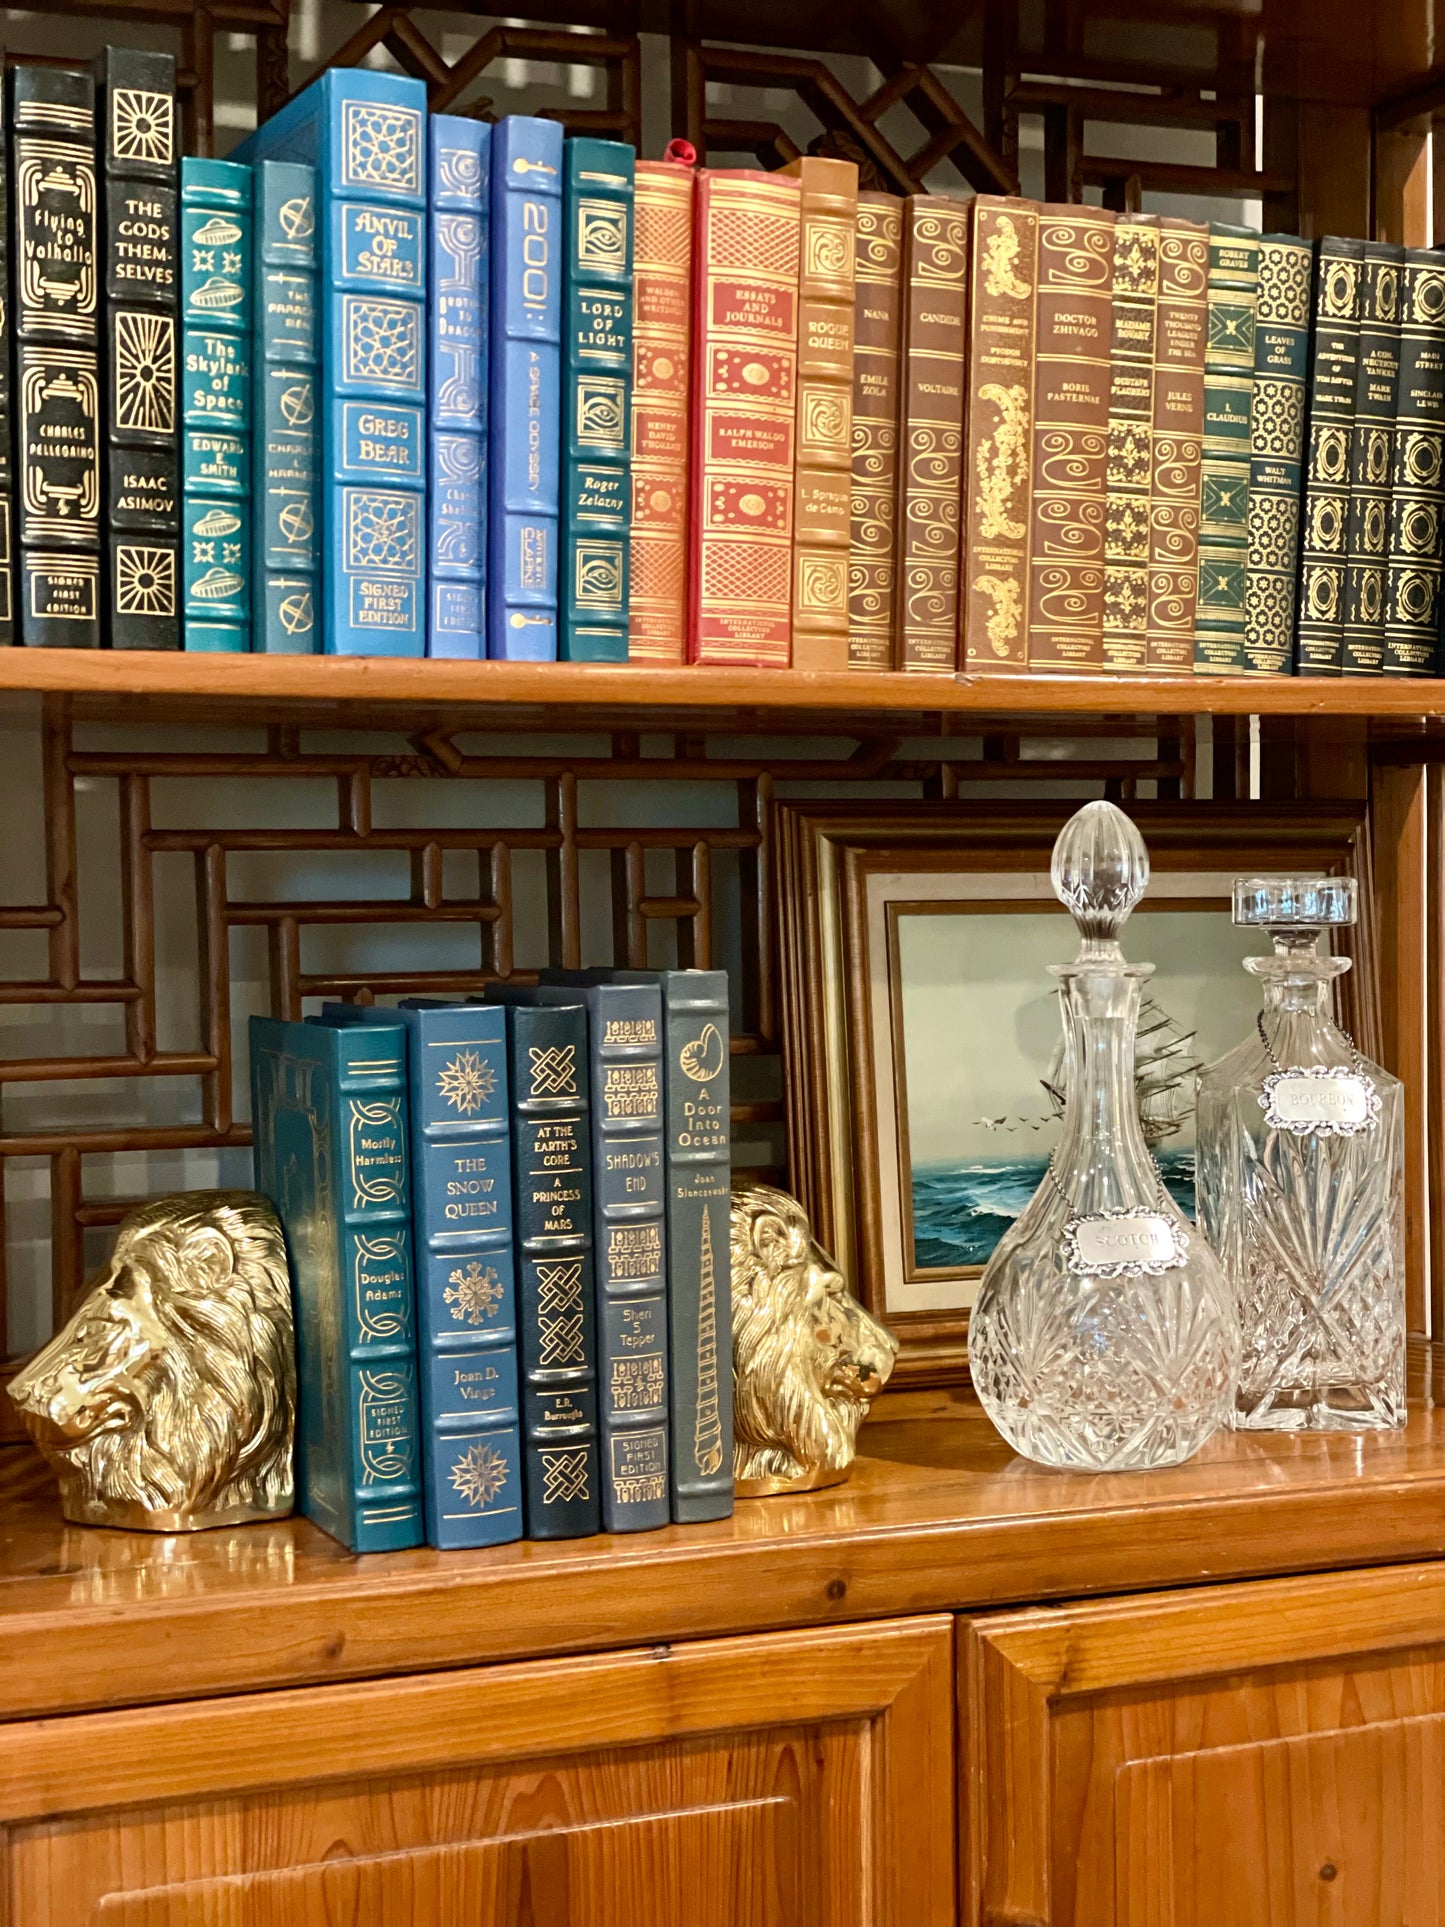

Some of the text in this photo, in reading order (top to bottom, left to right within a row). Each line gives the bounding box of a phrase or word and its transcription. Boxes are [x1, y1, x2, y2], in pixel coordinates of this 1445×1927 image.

[125, 200, 162, 219] THE
[34, 209, 85, 236] Flying
[355, 212, 413, 239] ANVIL
[57, 226, 74, 245] to
[119, 221, 170, 241] GODS
[26, 240, 92, 264] Valhalla
[115, 242, 172, 262] THEM-
[372, 235, 398, 256] OF
[1218, 249, 1249, 260] ROBERT
[356, 251, 413, 278] STARS
[1219, 260, 1248, 269] GRAVES
[116, 263, 173, 284] SELVES
[640, 295, 658, 304] AND
[735, 290, 776, 303] ESSAYS
[581, 302, 623, 318] LORD
[743, 302, 769, 313] AND
[724, 311, 783, 328] JOURNALS
[864, 309, 889, 321] NANA
[920, 312, 960, 326] CANDIDE
[1054, 313, 1097, 326] DOCTOR
[1168, 312, 1199, 321] TWENTY
[593, 318, 613, 331] OF
[808, 321, 849, 335] ROGUE
[1053, 325, 1098, 337] ZHIVAGO
[1116, 319, 1151, 331] MADAME
[1165, 321, 1201, 331] THOUSAND
[578, 332, 625, 347] LIGHT
[1117, 329, 1150, 340] BOVARY
[1167, 330, 1198, 340] LEAGUES
[1265, 335, 1295, 346] LEAVES
[205, 339, 235, 358] The
[808, 337, 849, 351] QUEEN
[1170, 339, 1195, 348] UNDER
[1168, 349, 1181, 357] THE
[1274, 346, 1286, 355] OF
[1420, 351, 1440, 360] MAIN
[186, 354, 249, 376] Skylark
[1267, 355, 1292, 365] GRASS
[1415, 360, 1443, 370] STREET
[1366, 366, 1396, 378] YANKEE
[212, 375, 229, 391] of
[860, 374, 888, 386] EMILE
[1114, 377, 1148, 387] GUSTAVE
[862, 386, 887, 397] ZOLA
[918, 383, 959, 396] VOLTAIRE
[1062, 382, 1090, 392] BORIS
[1369, 383, 1391, 393] MARK
[193, 389, 244, 411] Space
[1047, 392, 1100, 404] PASTERNAK
[1168, 391, 1193, 401] JULES
[1368, 392, 1392, 402] TWAIN
[1410, 389, 1443, 399] SINCLAIR
[1165, 401, 1193, 412] VERNE
[1416, 399, 1440, 408] LEWIS
[1206, 412, 1248, 425] CLAUDIUS
[39, 424, 86, 440] CHARLES
[358, 414, 409, 439] GREG
[647, 422, 677, 431] HENRY
[649, 431, 676, 441] DAVID
[719, 427, 785, 441] RALPH WALDO
[192, 438, 243, 454] EDWARD
[731, 438, 775, 450] EMERSON
[29, 443, 94, 459] PELLEGRINO
[359, 440, 410, 464] BEAR
[200, 463, 237, 477] SMITH
[1265, 466, 1286, 476] WALT
[123, 475, 167, 491] ISAAC
[584, 477, 620, 493] Roger
[1256, 475, 1292, 485] WHITMAN
[117, 496, 173, 512] ASIMOV
[578, 493, 624, 510] Zelazny
[805, 503, 818, 513] de
[359, 582, 409, 598] SIGNED
[364, 597, 402, 610] FIRST
[359, 610, 409, 624] EDITION
[699, 1088, 710, 1100] A
[684, 1102, 723, 1116] Door
[688, 1118, 720, 1131] Into
[537, 1126, 573, 1138] AT THE
[361, 1137, 396, 1150] Mostly
[534, 1139, 578, 1152] EARTH'S
[678, 1132, 727, 1147] Ocean
[454, 1158, 486, 1172] THE
[543, 1154, 571, 1166] CORE
[606, 1152, 660, 1170] SHADOW'S
[553, 1177, 562, 1188] A
[626, 1176, 646, 1193] END
[694, 1173, 716, 1184] Joan
[447, 1179, 494, 1195] SNOW
[532, 1190, 581, 1203] PRINCESS
[445, 1201, 497, 1219] QUEEN
[551, 1205, 565, 1216] OF
[544, 1219, 573, 1231] MARS
[1096, 1233, 1159, 1248] SCOTCH
[361, 1272, 404, 1285] Douglas
[366, 1290, 402, 1301] Adams
[620, 1334, 655, 1348] Tepper
[454, 1367, 499, 1385] Joan D.
[460, 1386, 496, 1400] Vinge
[555, 1398, 573, 1408] E.R.
[371, 1406, 404, 1418] SIGNED
[377, 1416, 401, 1426] FIRST
[622, 1438, 659, 1450] SIGNED
[626, 1451, 656, 1462] FIRST
[620, 1462, 662, 1475] EDITION
